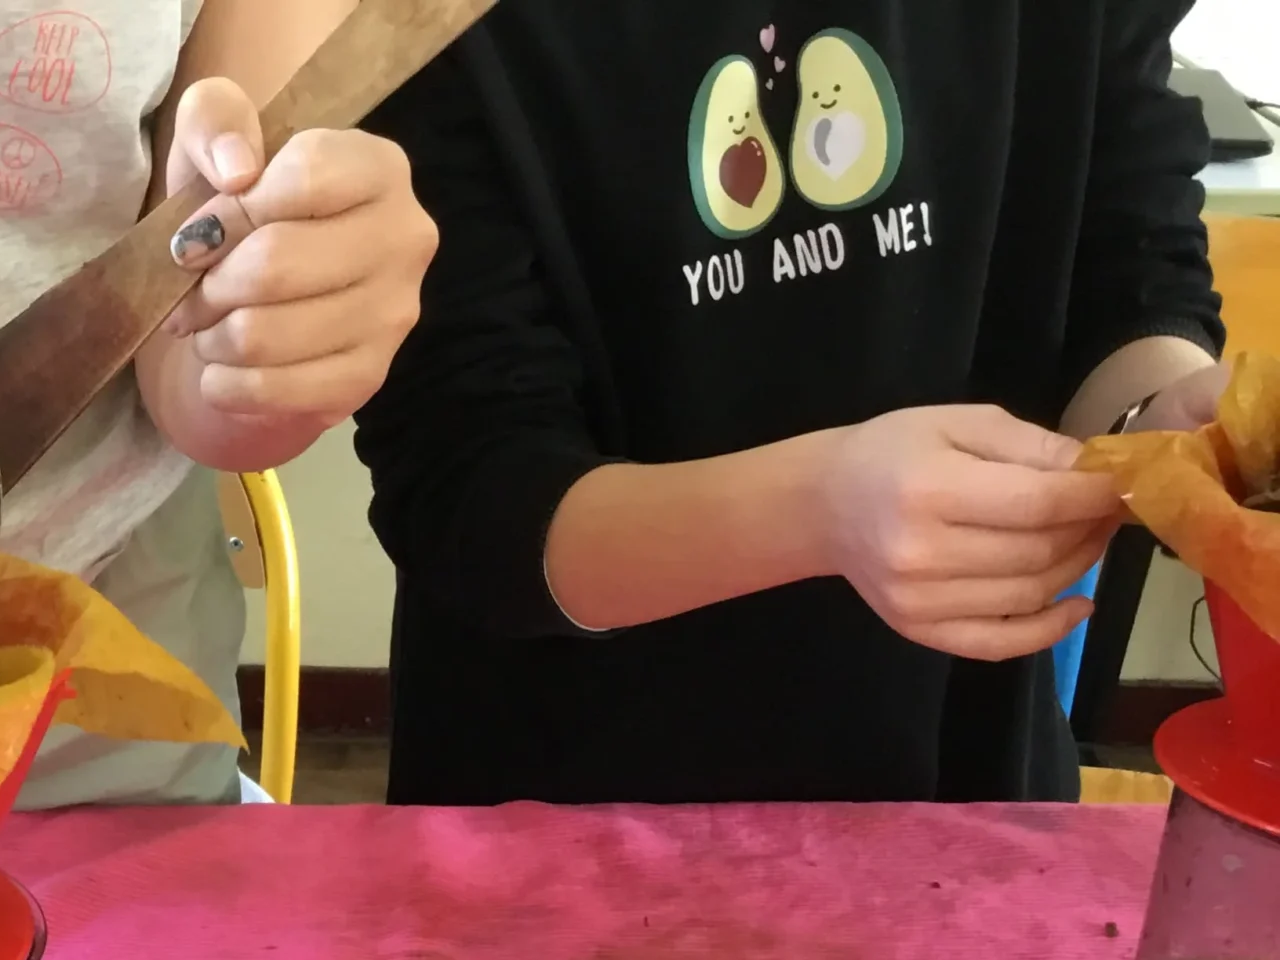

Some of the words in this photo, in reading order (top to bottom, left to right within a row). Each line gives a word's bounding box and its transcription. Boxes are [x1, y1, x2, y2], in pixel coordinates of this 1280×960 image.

[682, 248, 745, 306] YOU
[773, 222, 845, 283] AND
[872, 201, 933, 257] ME!
